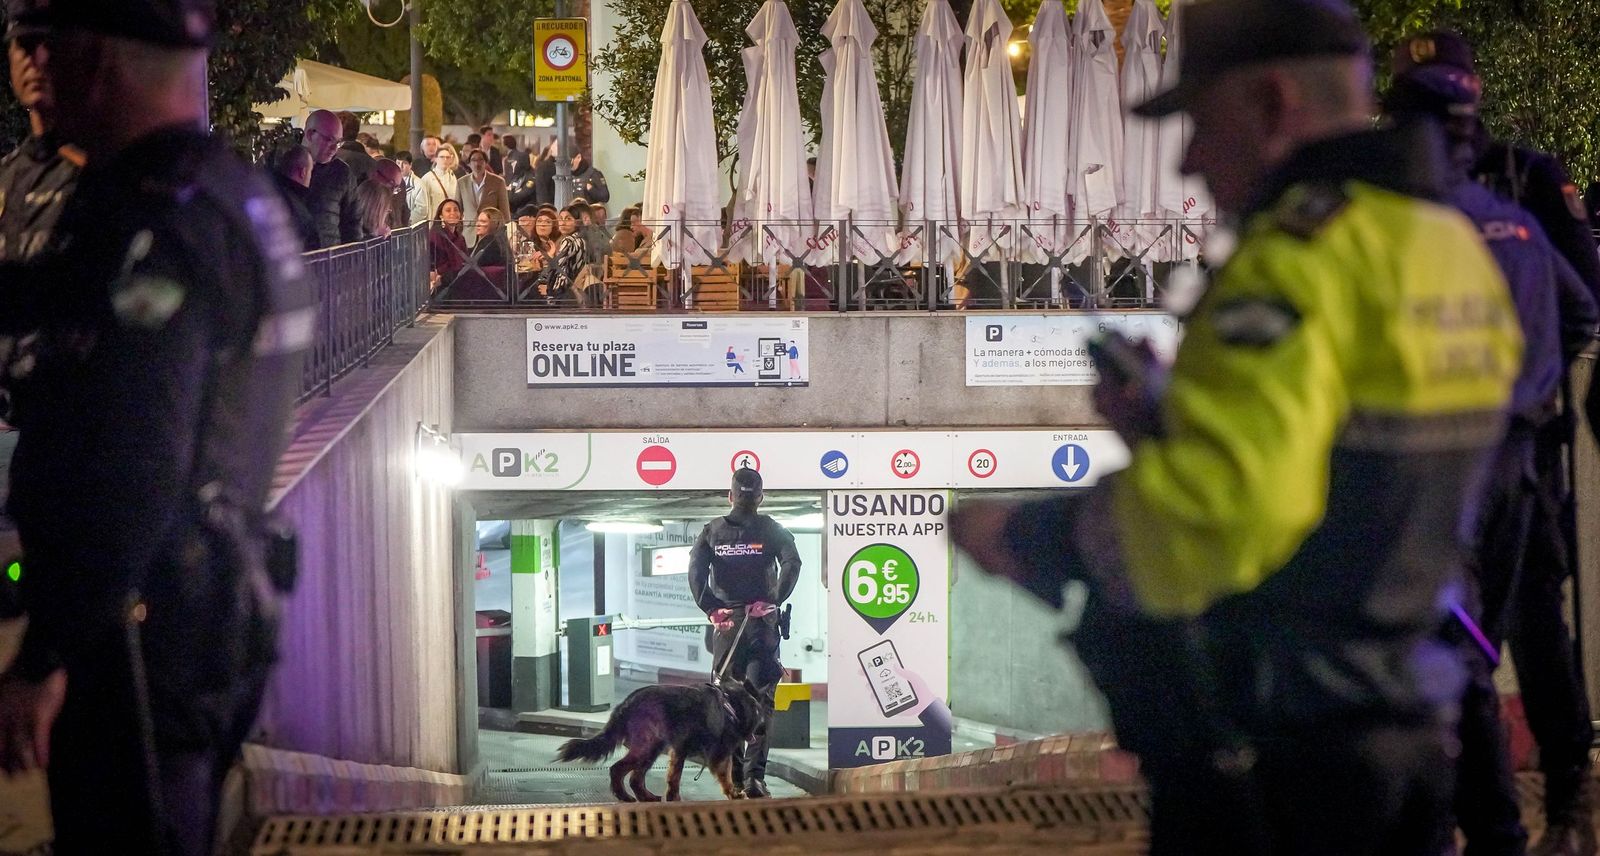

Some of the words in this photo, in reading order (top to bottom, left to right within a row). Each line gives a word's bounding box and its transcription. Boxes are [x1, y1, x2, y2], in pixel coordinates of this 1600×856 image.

[532, 341, 583, 352] Reserva
[587, 341, 600, 352] tu
[603, 340, 636, 353] plaza
[973, 348, 986, 356] La
[988, 348, 1024, 356] manera
[1034, 347, 1072, 356] cómoda
[1075, 347, 1086, 356] de
[532, 353, 636, 378] ONLINE
[974, 359, 980, 368] Y
[1033, 358, 1046, 368] los
[1049, 358, 1087, 369] mejores
[470, 448, 559, 477] APK2
[976, 459, 990, 468] 20
[833, 494, 944, 516] USANDO
[834, 523, 908, 536] NUESTRA
[912, 523, 944, 536] APP
[635, 588, 662, 598] GARANTÍA
[909, 612, 925, 623] 24
[854, 736, 925, 760] APK2
